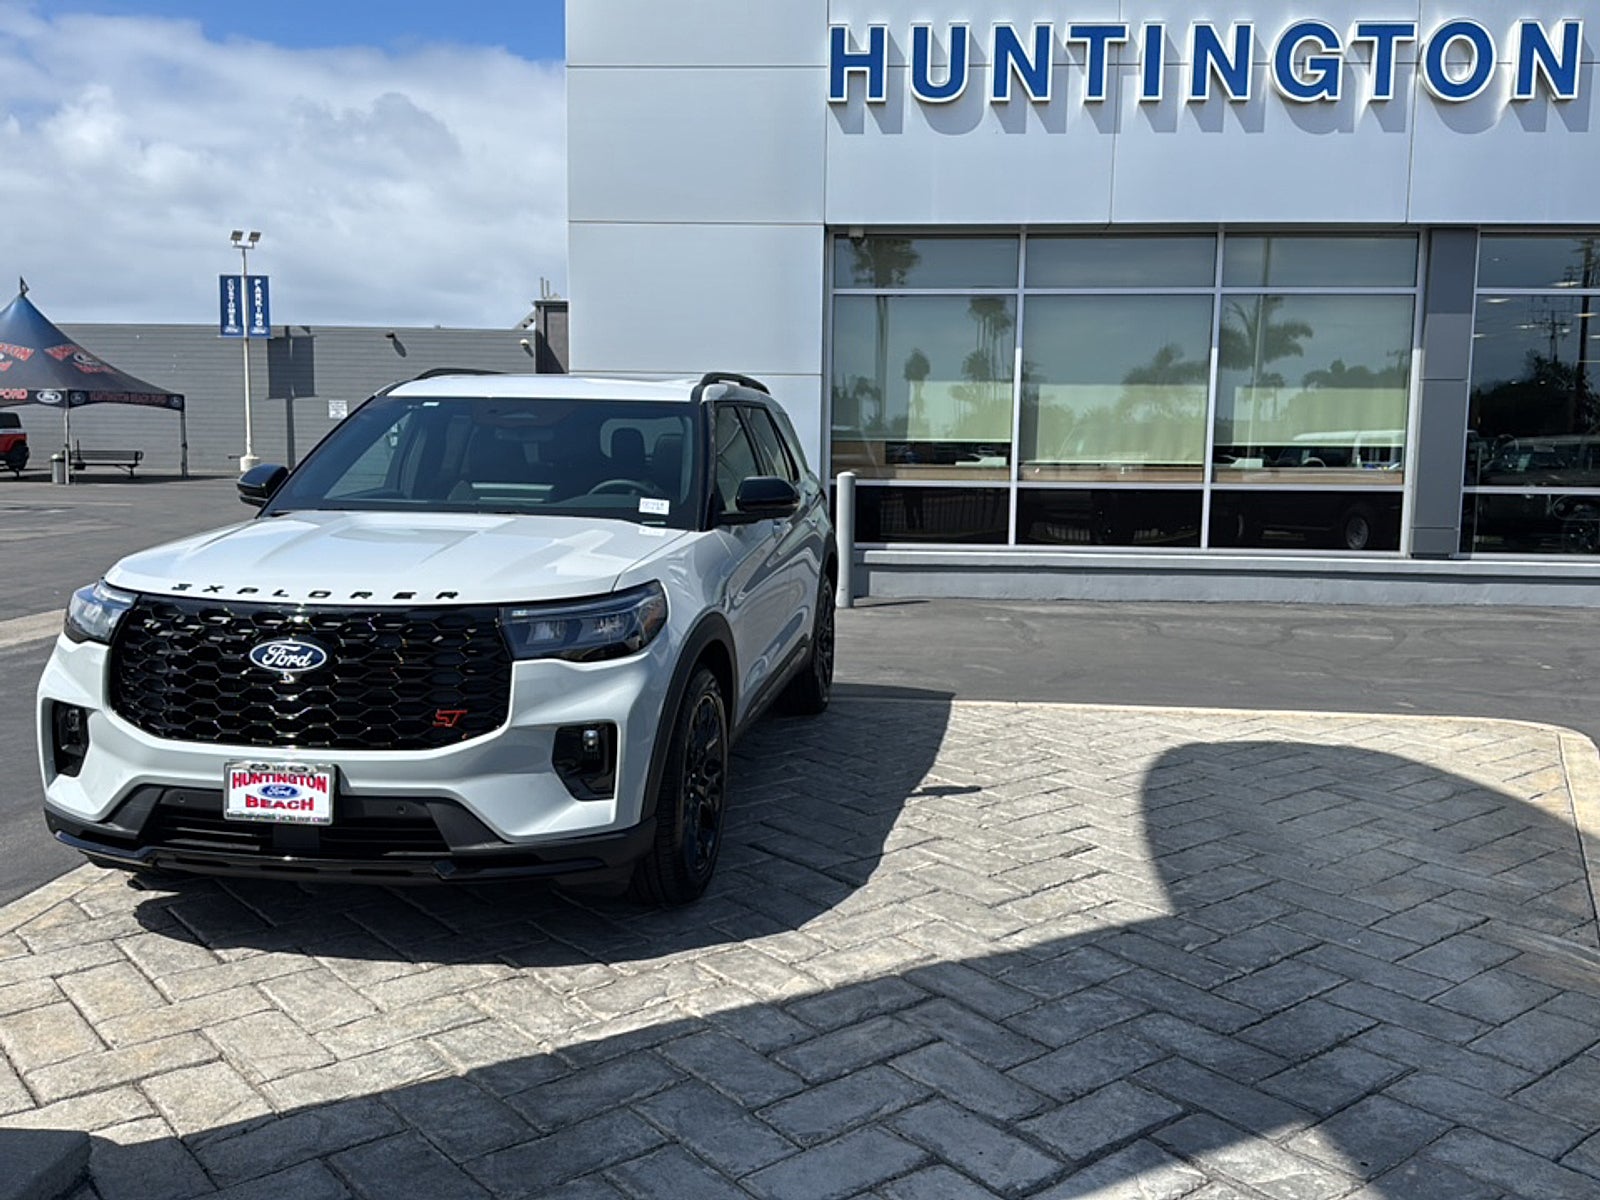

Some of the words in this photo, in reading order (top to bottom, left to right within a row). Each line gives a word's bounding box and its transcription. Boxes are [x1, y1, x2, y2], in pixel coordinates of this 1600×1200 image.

[828, 19, 1583, 102] HUNTINGTON
[254, 279, 263, 326] PARKING
[171, 583, 459, 599] EXPLORER
[261, 644, 313, 667] Ford
[432, 709, 468, 728] ST
[231, 771, 327, 794] HUNTINGTON
[245, 793, 314, 811] BEACH
